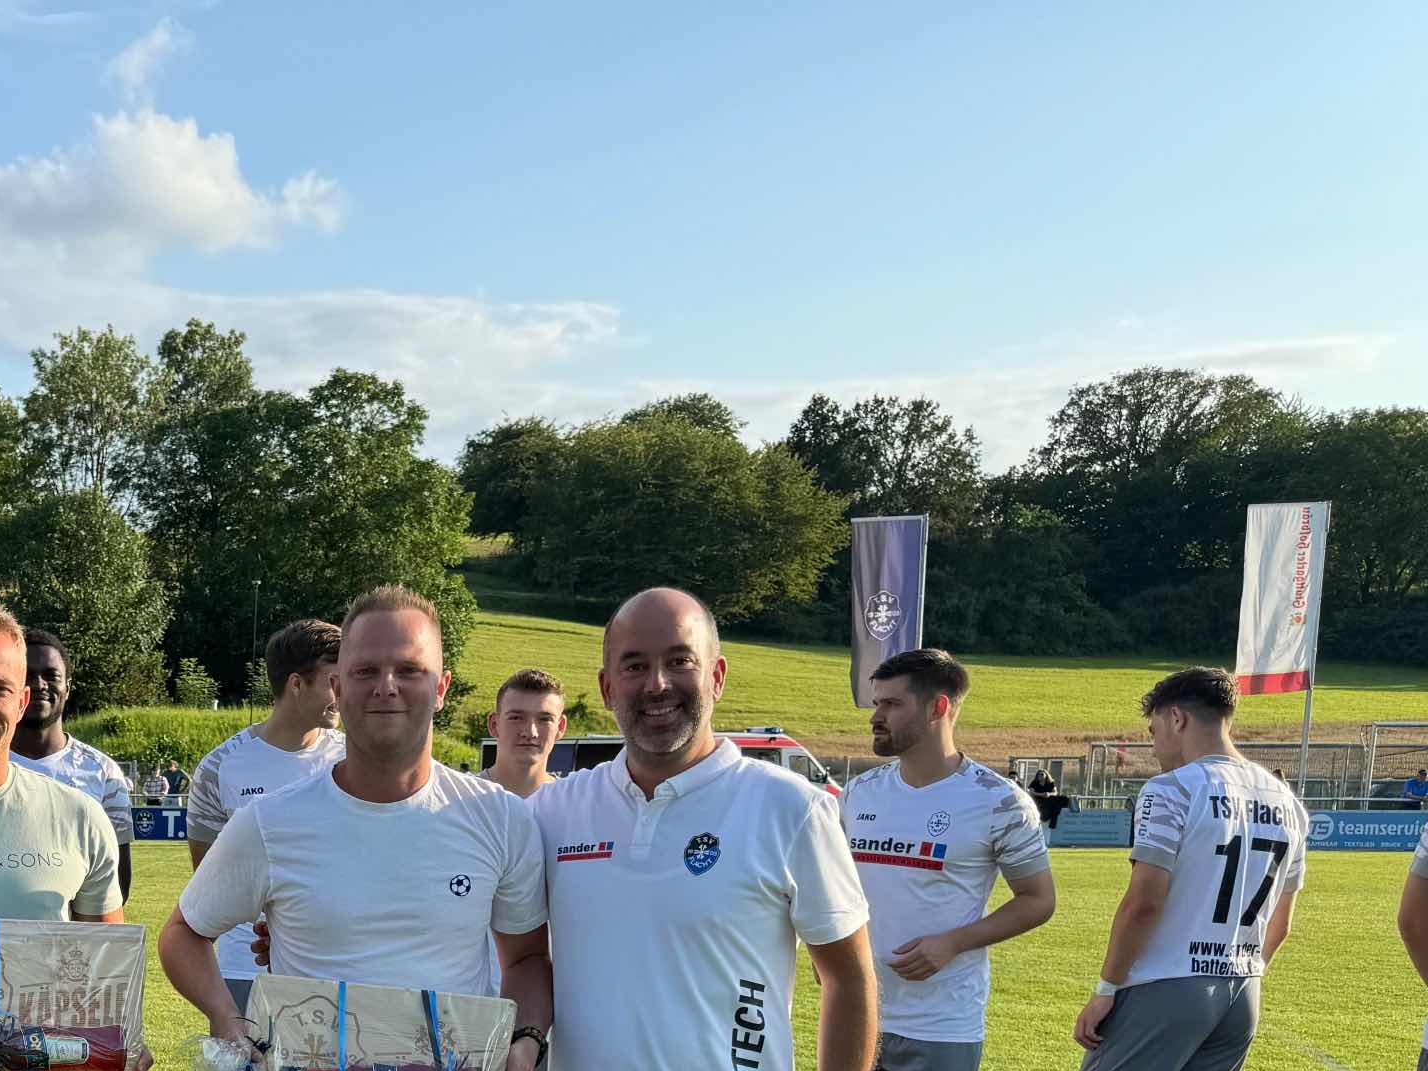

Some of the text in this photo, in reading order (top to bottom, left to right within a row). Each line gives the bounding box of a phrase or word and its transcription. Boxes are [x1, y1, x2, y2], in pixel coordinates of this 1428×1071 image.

[240, 786, 264, 796] JAKO
[856, 813, 876, 821] JAKO
[1209, 795, 1296, 830] TSV Flac
[557, 842, 596, 855] sander
[850, 837, 915, 854] sander
[7, 852, 64, 869] SONS
[1212, 835, 1290, 927] 17
